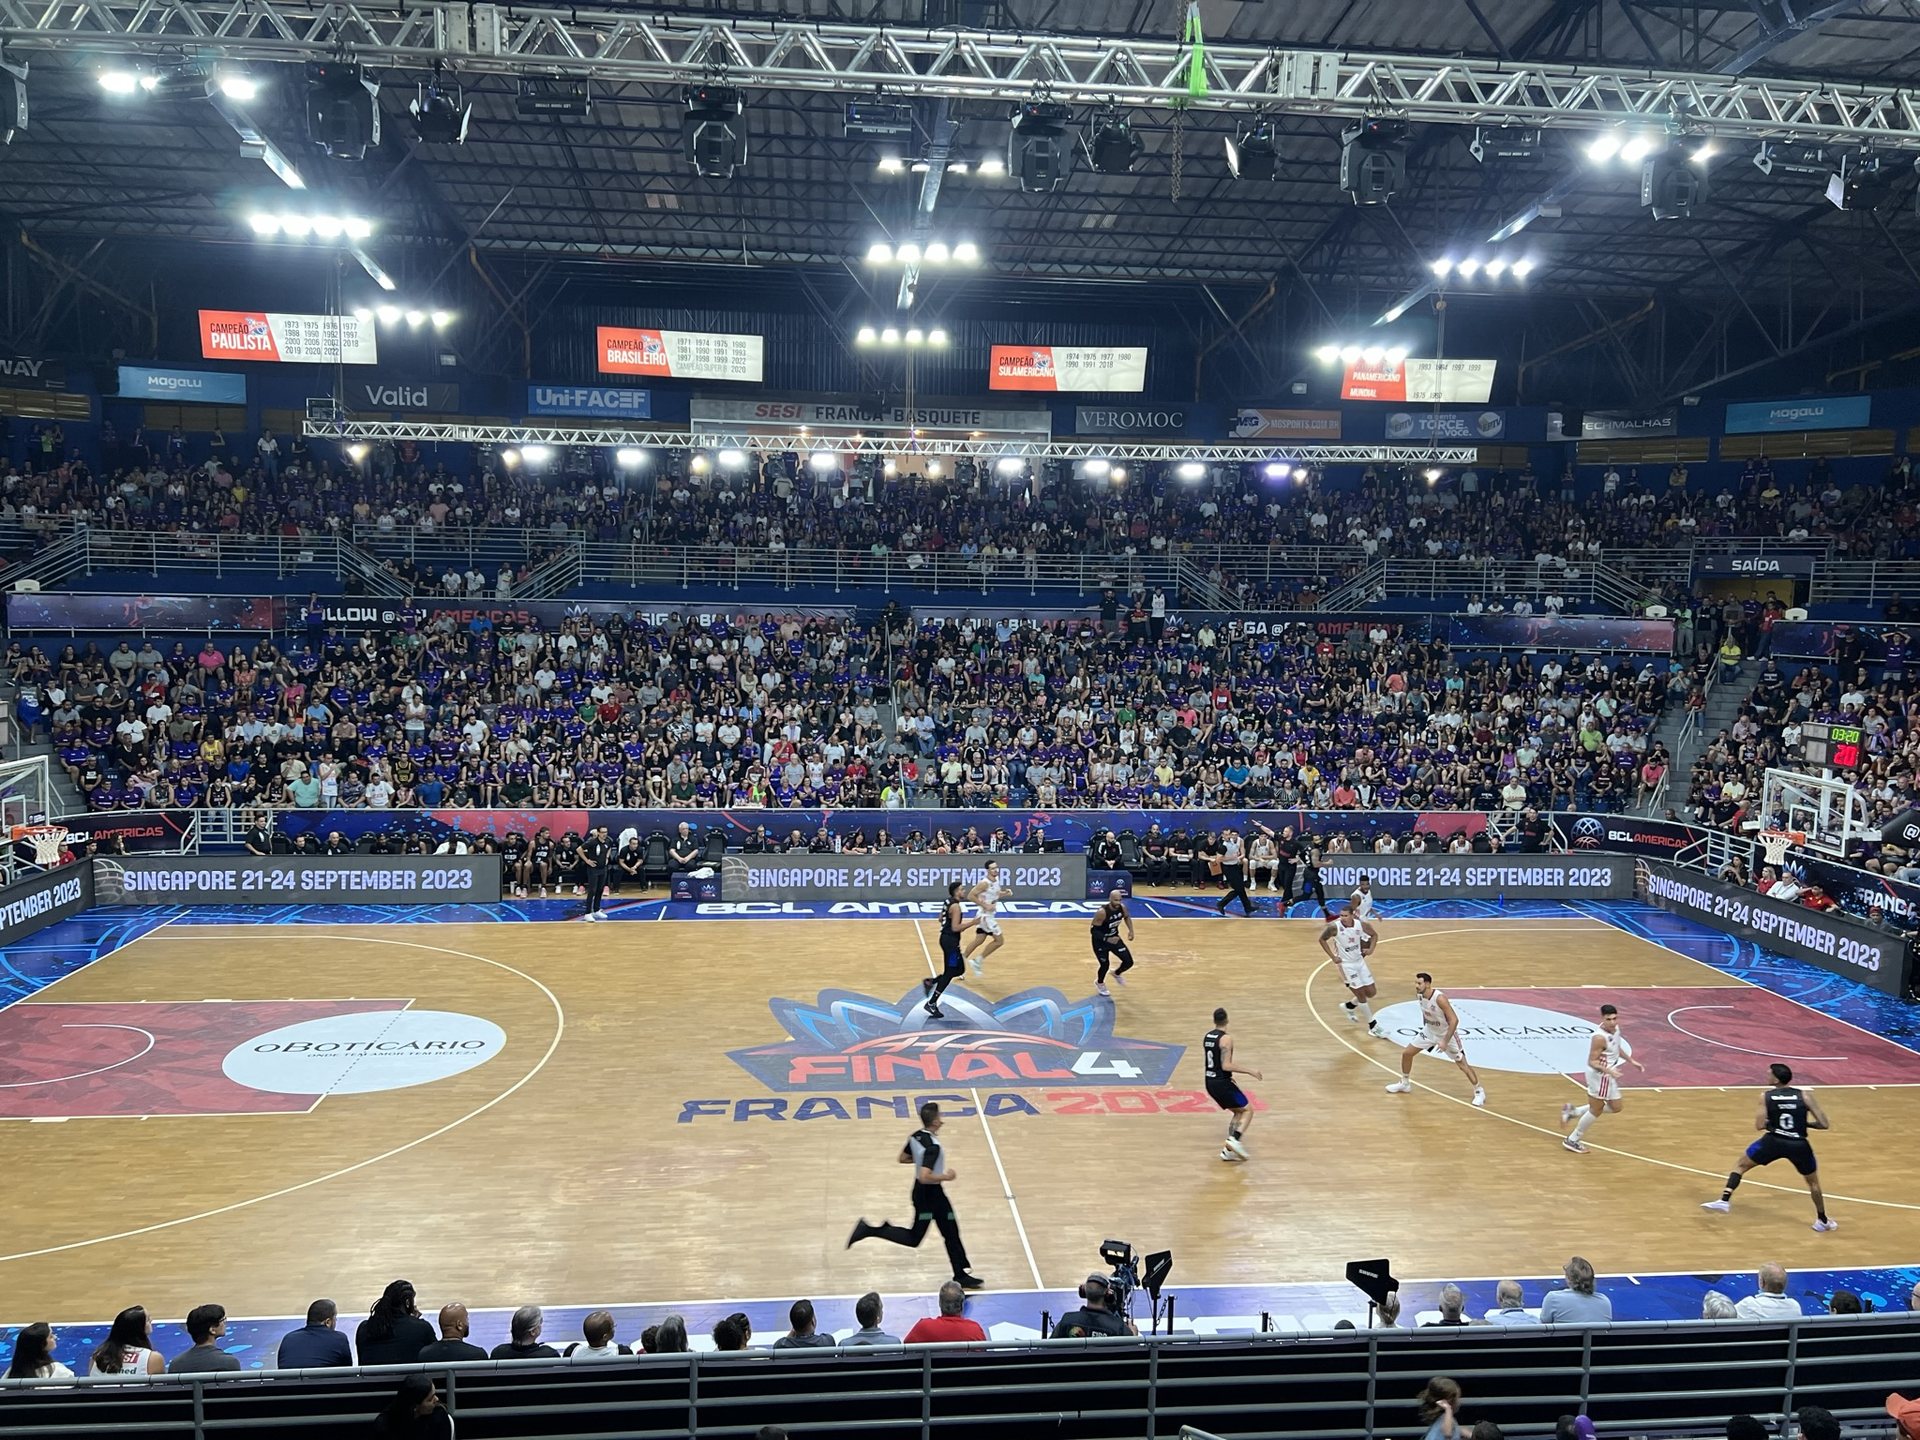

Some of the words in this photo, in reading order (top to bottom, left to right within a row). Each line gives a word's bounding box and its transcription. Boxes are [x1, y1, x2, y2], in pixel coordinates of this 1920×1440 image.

[210, 321, 249, 334] CAMPEÃO
[284, 320, 299, 329] 1973
[303, 321, 319, 329] 1975
[211, 333, 271, 350] PAULISTA
[285, 337, 300, 345] 2000
[343, 339, 359, 347] 2018
[607, 338, 643, 350] CAMPEÃO
[677, 338, 691, 346] 1971
[695, 338, 710, 346] 1974
[714, 339, 728, 347] 1975
[285, 346, 301, 354] 2019
[305, 347, 321, 355] 2020
[607, 350, 666, 365] BRASILEIRO
[999, 356, 1034, 367] CAMPEÃO
[731, 365, 746, 374] 2020
[998, 366, 1055, 377] SULAMERICANO
[1352, 372, 1401, 382] PANAMERICANO
[147, 375, 202, 389] Magalu
[364, 384, 428, 407] Valid
[535, 388, 646, 409] Uni-FACEF
[754, 404, 803, 418] SESI
[894, 409, 981, 424] BASQUETE
[1080, 410, 1183, 429] VEROMOC
[1731, 557, 1780, 571] SAÍDA
[300, 607, 377, 621] FLLOW
[1831, 728, 1860, 743] 03:20
[1833, 744, 1858, 767] 20
[123, 869, 236, 892] SINGAPORE
[241, 869, 296, 891] 21-24
[300, 869, 416, 891] SEPTEMBER
[421, 868, 473, 891] 2023
[747, 868, 848, 888] SINGAPORE
[853, 868, 901, 888] 21-24
[906, 867, 1011, 888] SEPTEMBR
[1014, 866, 1062, 887] 2023
[1415, 867, 1461, 888] 21-24
[1465, 867, 1564, 887] SEPTEMBER
[1568, 867, 1612, 888] 2023
[53, 877, 82, 907] 2023
[695, 901, 805, 914] BCL
[1648, 874, 1712, 912] SINGAPORE
[1713, 897, 1749, 925] 21-24
[1752, 907, 1835, 956] SEPTEMBER
[1837, 937, 1881, 972] 2023
[788, 1051, 1076, 1084] FINAL
[1069, 1051, 1143, 1080] 4
[1040, 1091, 1269, 1115] 202
